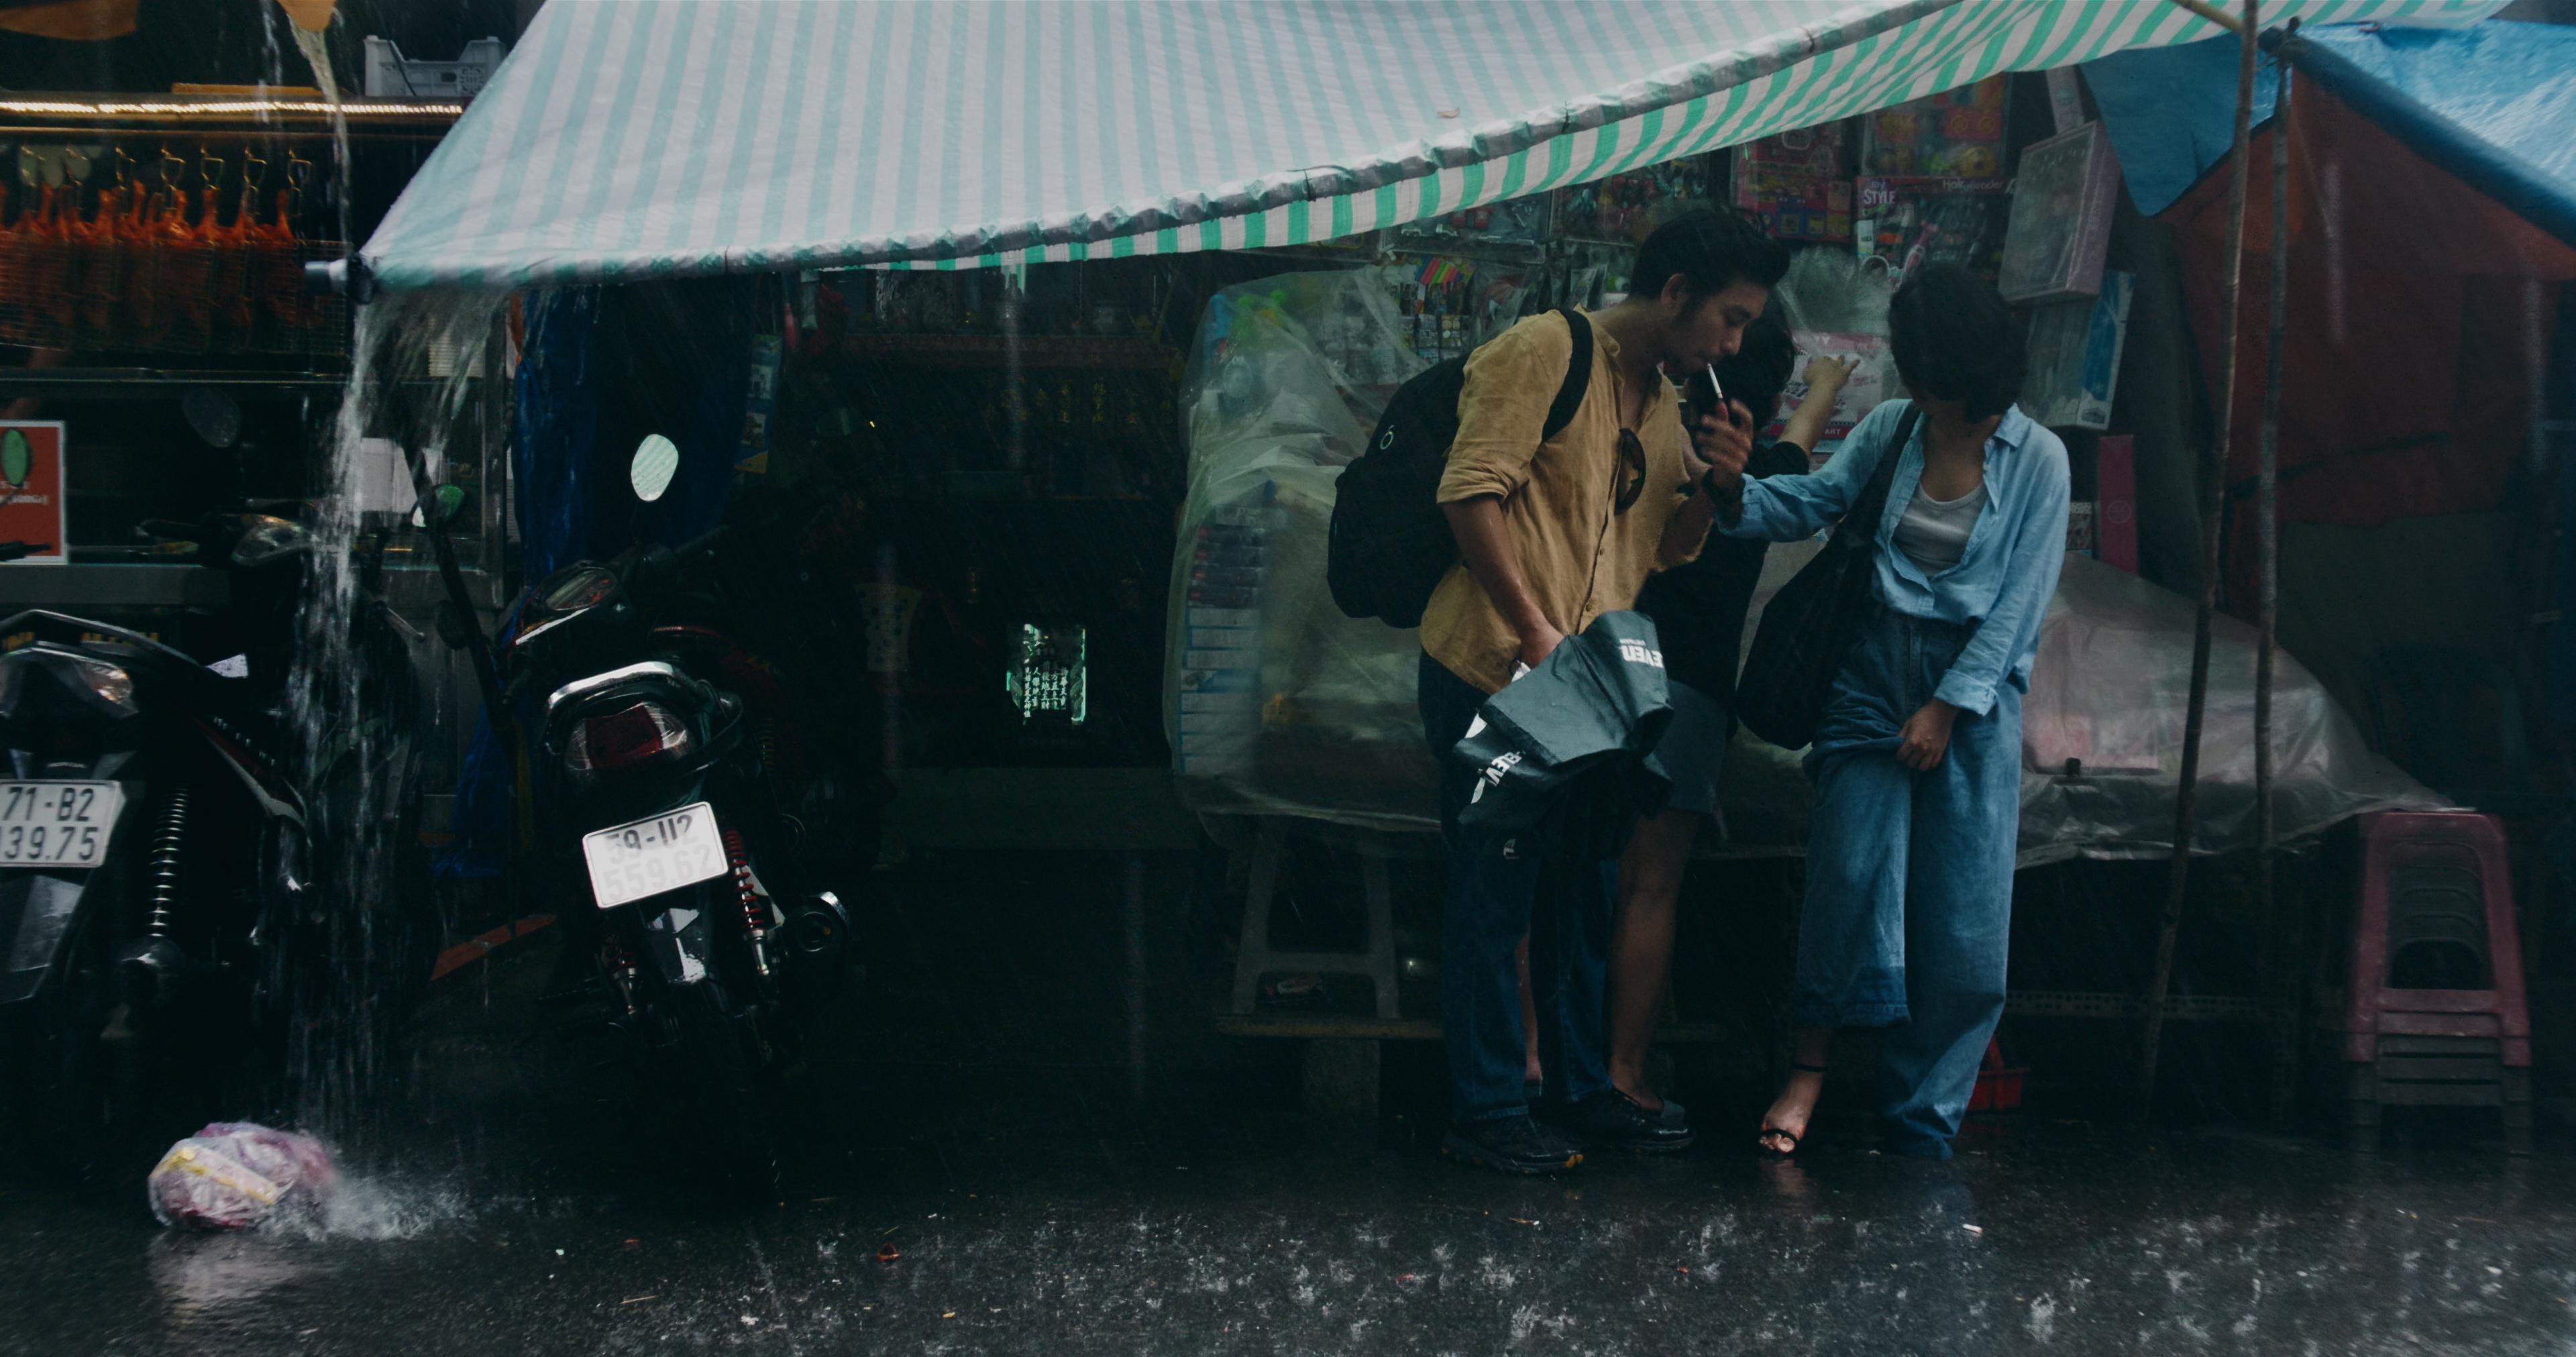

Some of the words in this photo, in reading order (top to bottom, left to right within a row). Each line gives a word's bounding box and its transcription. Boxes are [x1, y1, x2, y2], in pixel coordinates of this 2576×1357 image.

[1863, 188, 1896, 205] STYLE
[3, 786, 95, 822] 71-B2
[0, 826, 99, 861] 39.75
